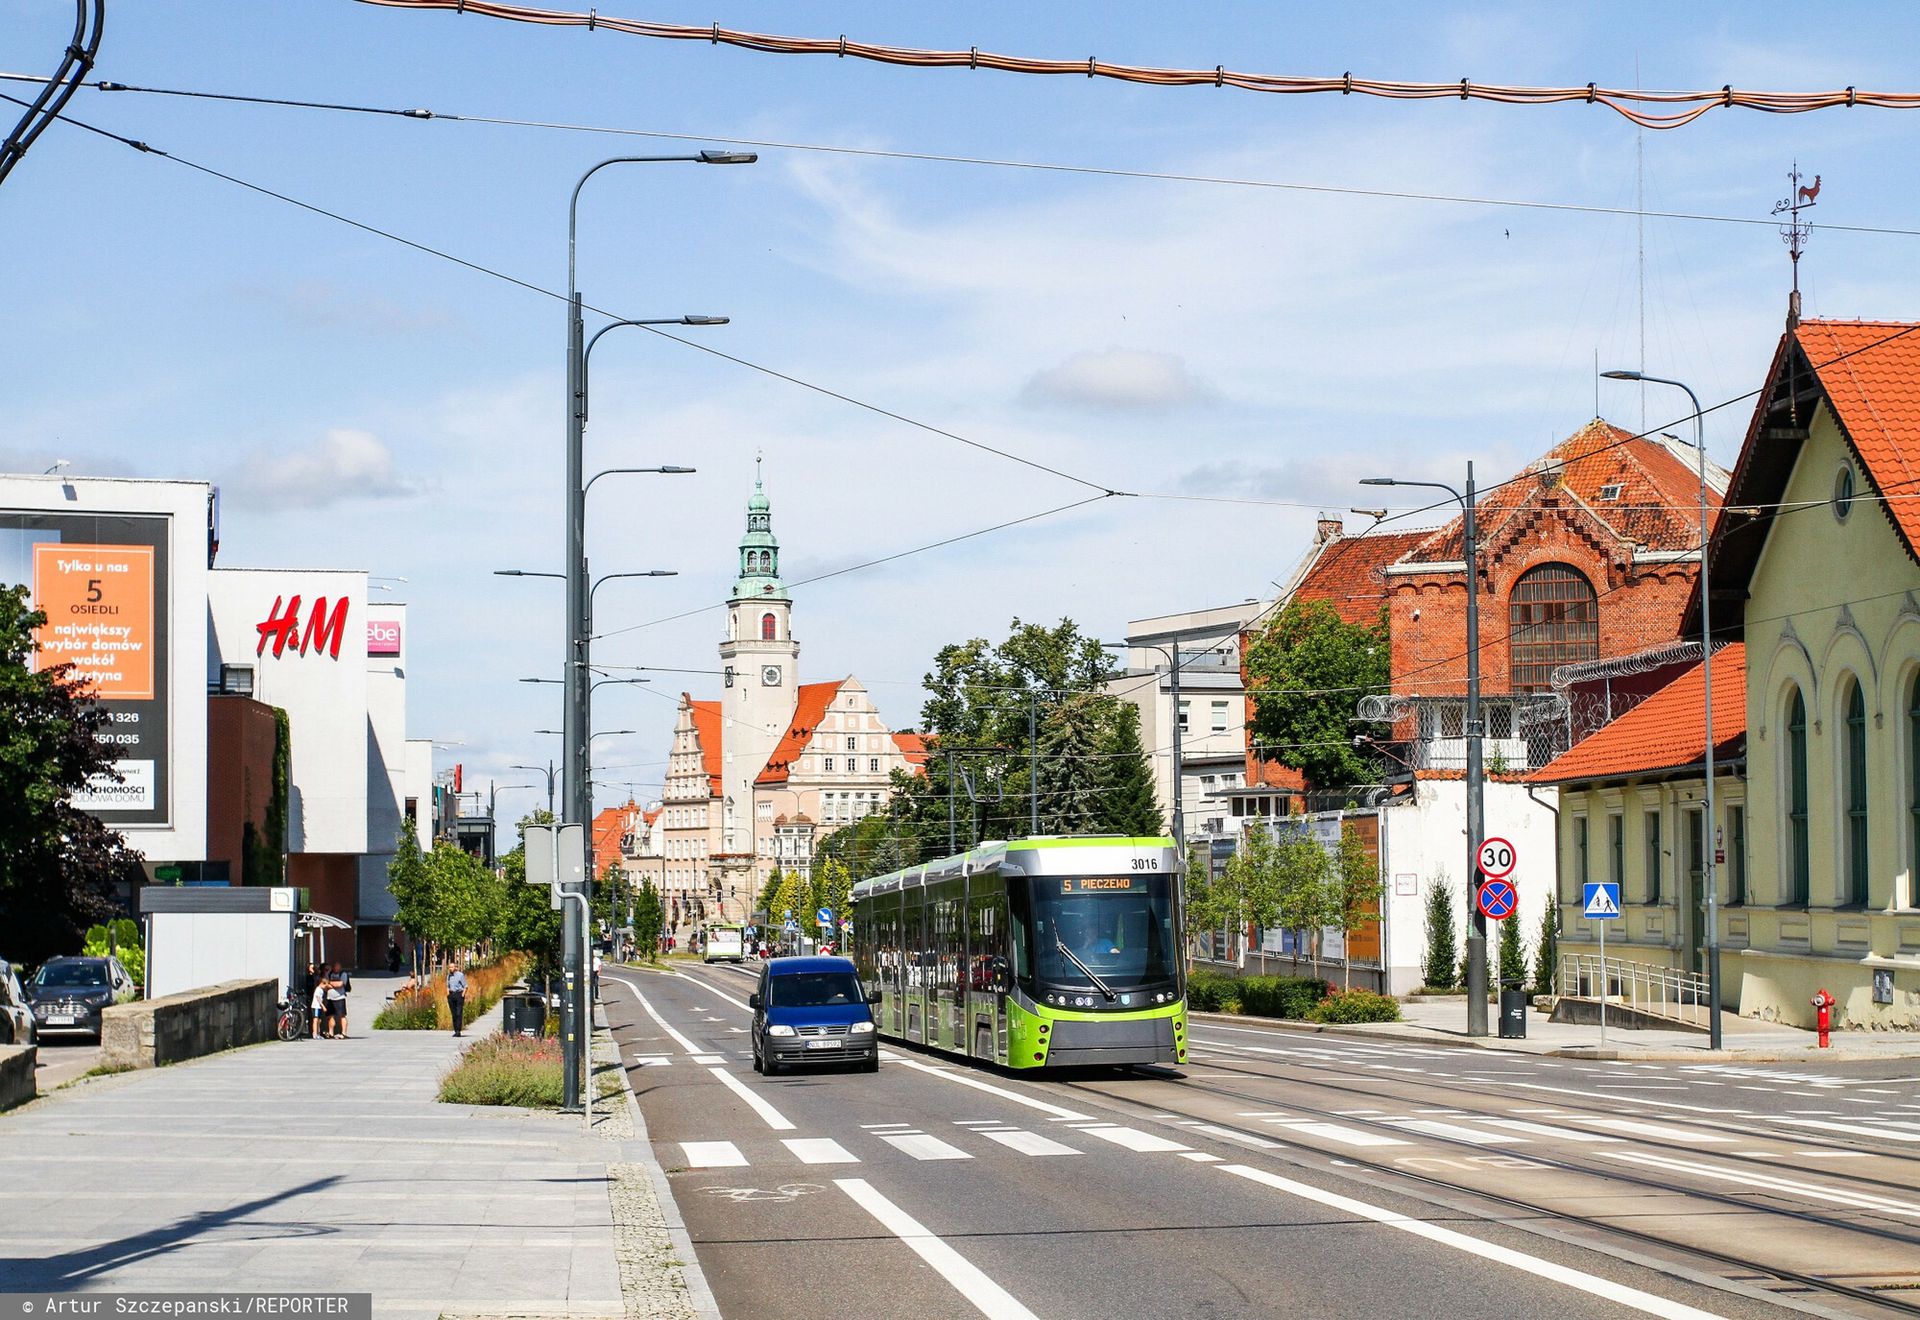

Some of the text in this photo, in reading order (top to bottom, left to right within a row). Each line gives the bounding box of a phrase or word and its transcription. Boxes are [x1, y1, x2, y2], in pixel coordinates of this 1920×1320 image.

[57, 560, 128, 574] Tylko u nas
[87, 580, 102, 602] 5
[70, 605, 119, 615] OSIEDLI
[54, 623, 131, 638] największy
[256, 594, 349, 661] H&M
[43, 638, 142, 653] wybór domów
[71, 653, 115, 665] wokół
[116, 712, 139, 722] 326
[116, 734, 140, 744] 035
[115, 795, 145, 803] DOMU
[1483, 848, 1510, 867] 30
[1131, 858, 1158, 870] 3016
[1064, 879, 1130, 891] 5 PIECZEWO
